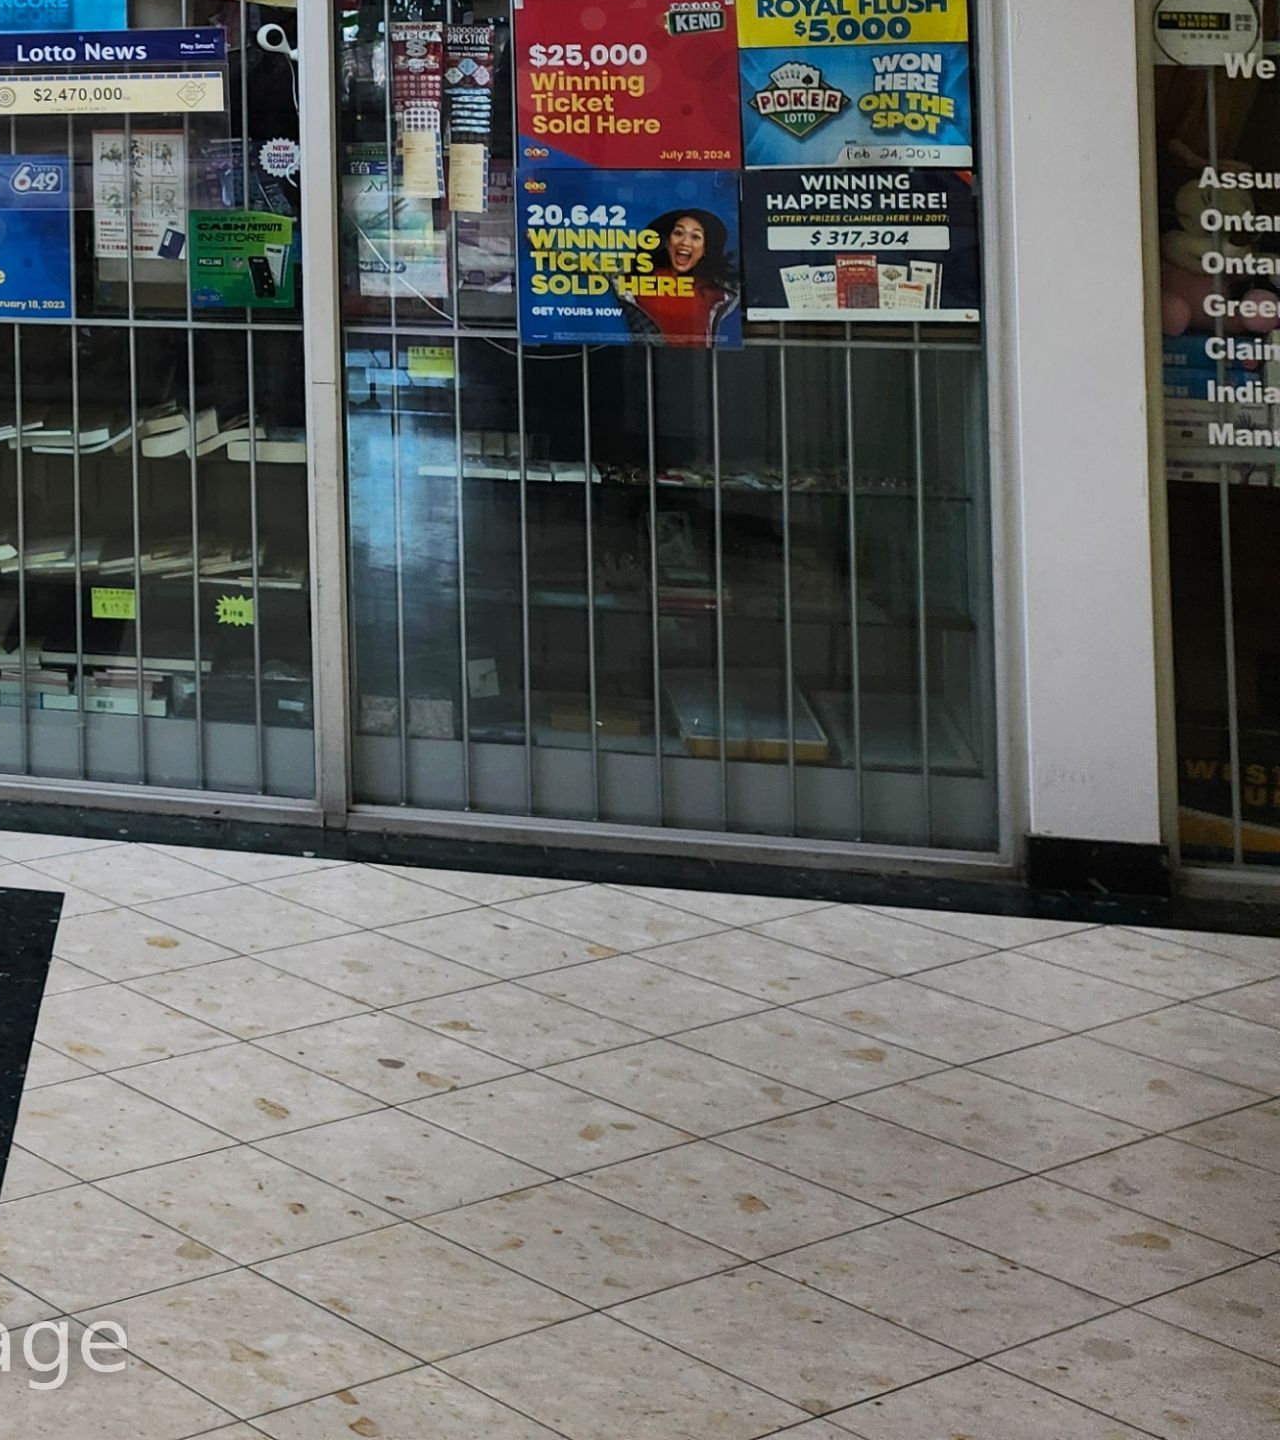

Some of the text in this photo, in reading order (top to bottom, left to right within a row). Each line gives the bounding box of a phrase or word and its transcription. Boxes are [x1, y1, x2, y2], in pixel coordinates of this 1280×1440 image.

[794, 16, 912, 43] $5,000
[17, 43, 148, 62] Lotto News
[529, 43, 648, 71] $25,000
[871, 53, 943, 74] WON
[1223, 51, 1276, 81] We
[530, 70, 646, 97] Winning
[874, 72, 940, 94] HERE
[33, 87, 123, 104] $2,470,000
[530, 93, 615, 113] Ticket
[759, 90, 839, 111] POKER
[858, 91, 957, 119] ON THE
[532, 115, 661, 134] Sold Here
[785, 113, 816, 123] LOTTO
[870, 111, 939, 135] SPOT
[272, 143, 290, 152] NEW
[846, 148, 871, 161] Feb
[766, 192, 948, 210] HAPPENS HERE!
[527, 204, 627, 227] 20,642
[197, 222, 283, 232] CASH PAYOUTS
[197, 232, 266, 243] IN-STORE
[528, 228, 661, 250] WINNING
[809, 230, 910, 248] $ 317,304
[530, 251, 654, 274] TICKETS
[531, 274, 696, 297] SOLD HERE
[42, 300, 66, 310] 2023
[532, 306, 623, 317] GET YOURS NOW
